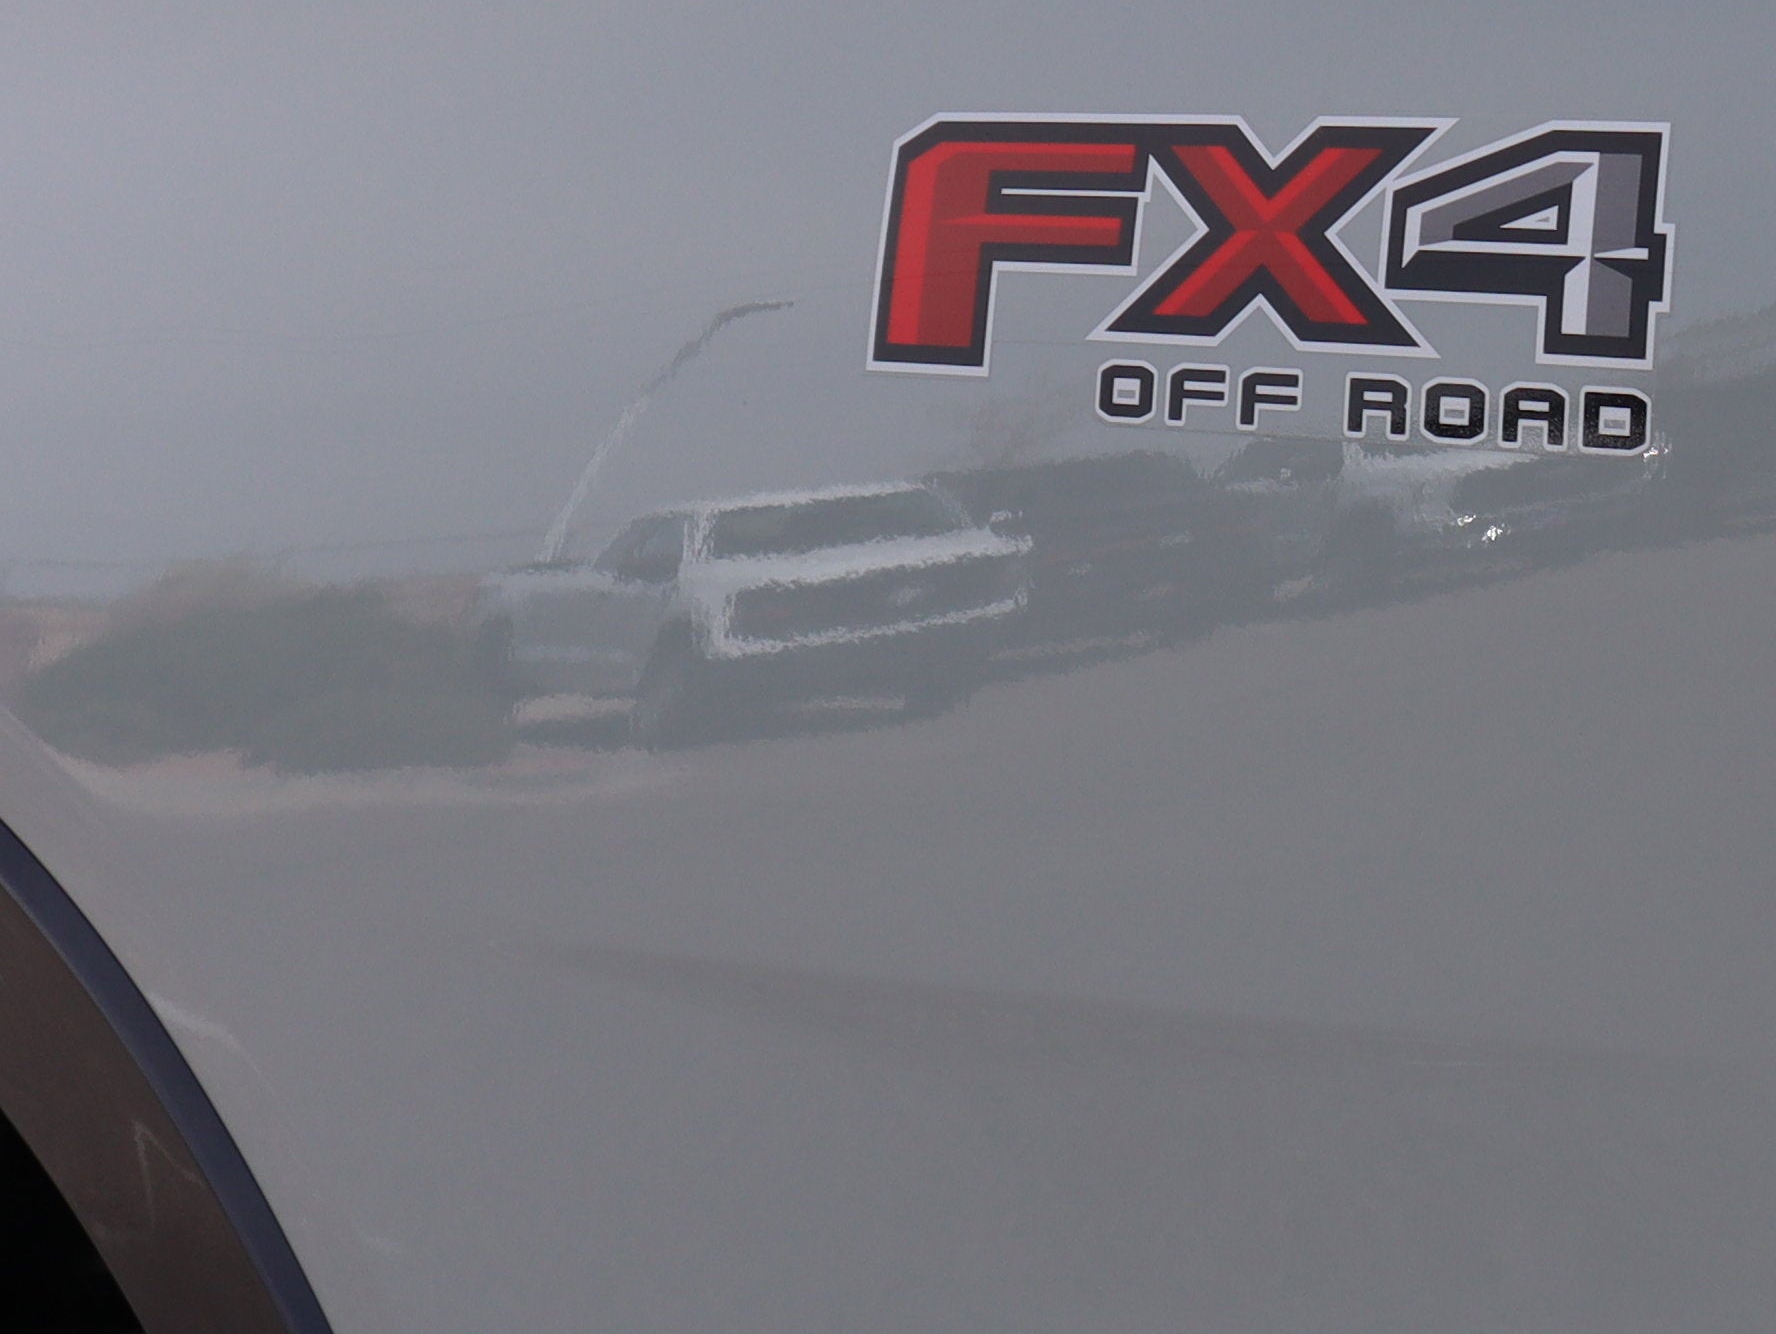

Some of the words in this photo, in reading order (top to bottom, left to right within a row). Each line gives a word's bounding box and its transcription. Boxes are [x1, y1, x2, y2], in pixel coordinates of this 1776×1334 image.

[866, 113, 1675, 378] FX4
[1095, 359, 1304, 431] OFF
[1343, 371, 1652, 457] ROAD
